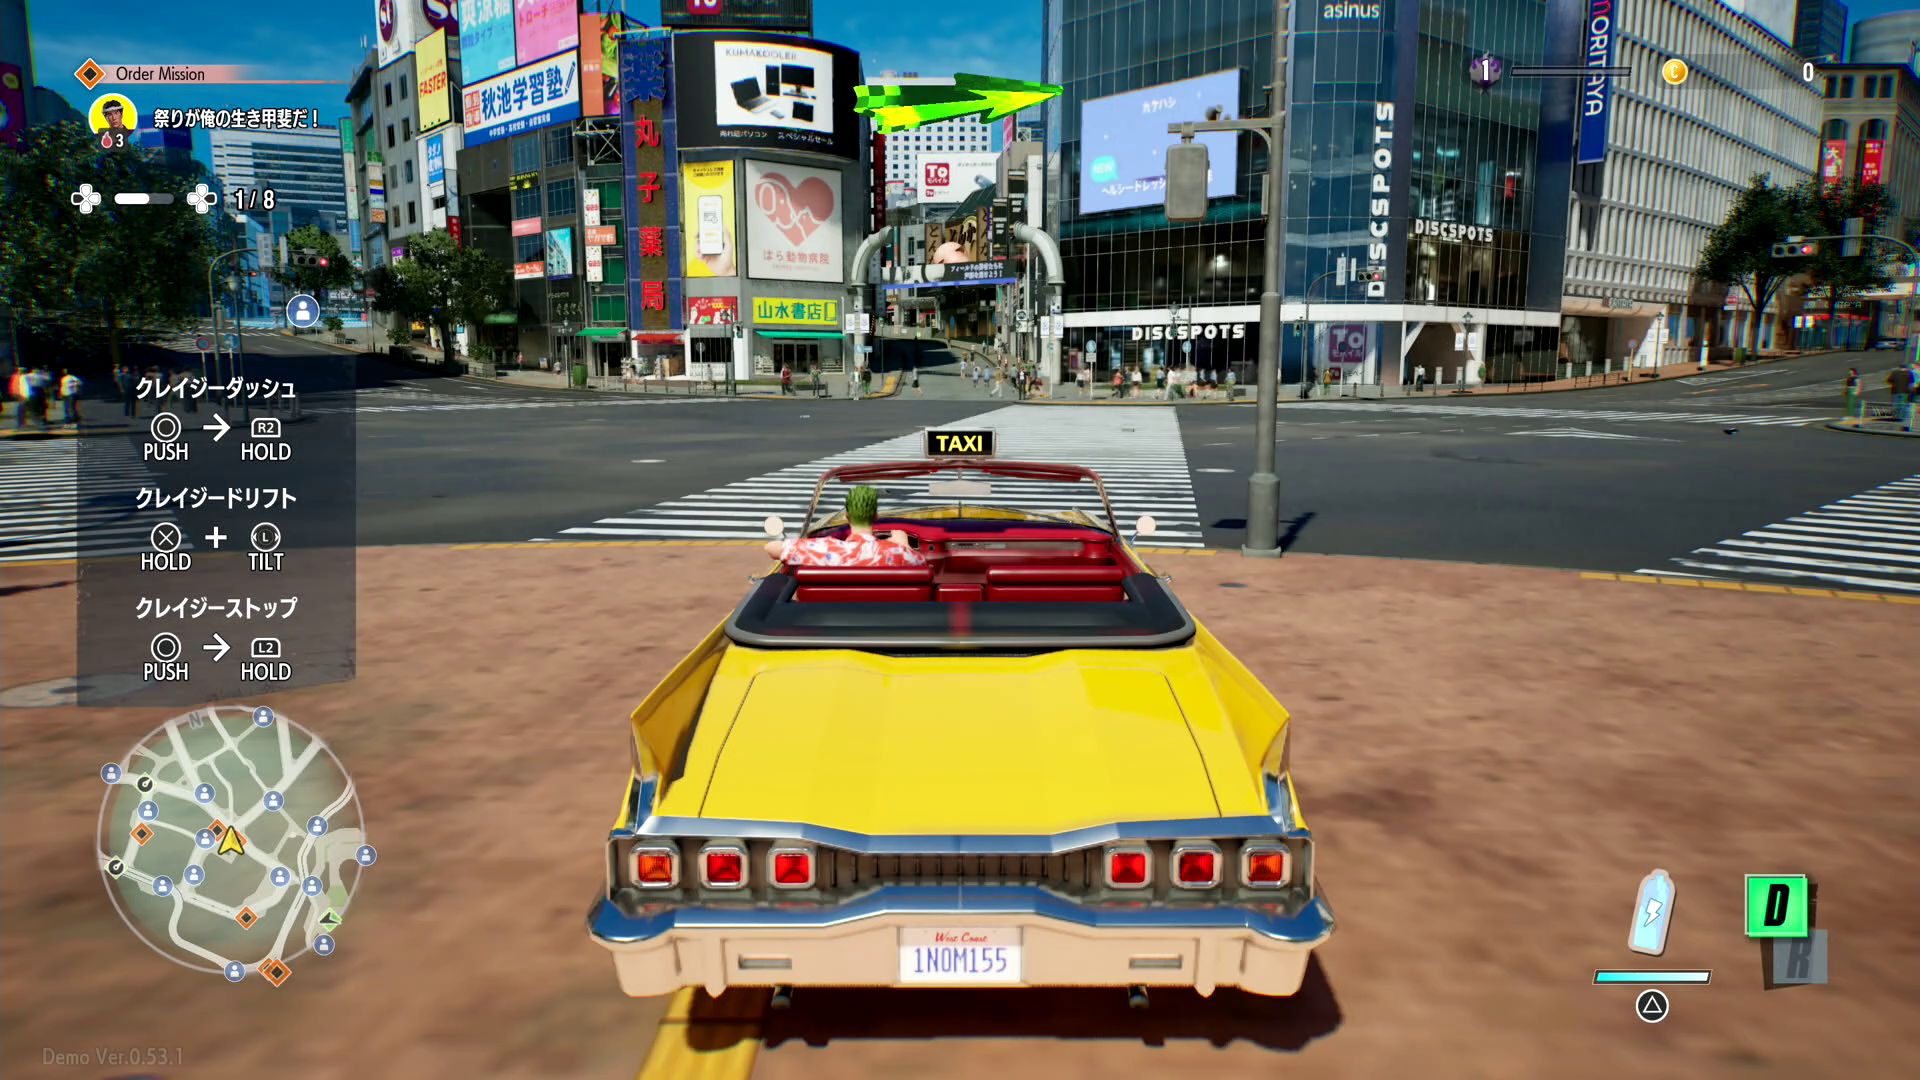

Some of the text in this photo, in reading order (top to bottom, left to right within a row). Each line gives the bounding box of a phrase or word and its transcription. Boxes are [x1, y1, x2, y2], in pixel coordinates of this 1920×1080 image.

[1323, 1, 1381, 19] asinus
[419, 71, 447, 96] FASTER
[481, 65, 563, 120] 秋池学習塾
[927, 166, 948, 179] To
[635, 115, 665, 311] 丸子薬局
[1415, 219, 1493, 243] DISCSPOTS
[763, 249, 830, 265] はら動物病院
[758, 301, 822, 321] 山水書店
[1131, 324, 1245, 341] DISCSPOTS
[935, 435, 983, 452] TAXI
